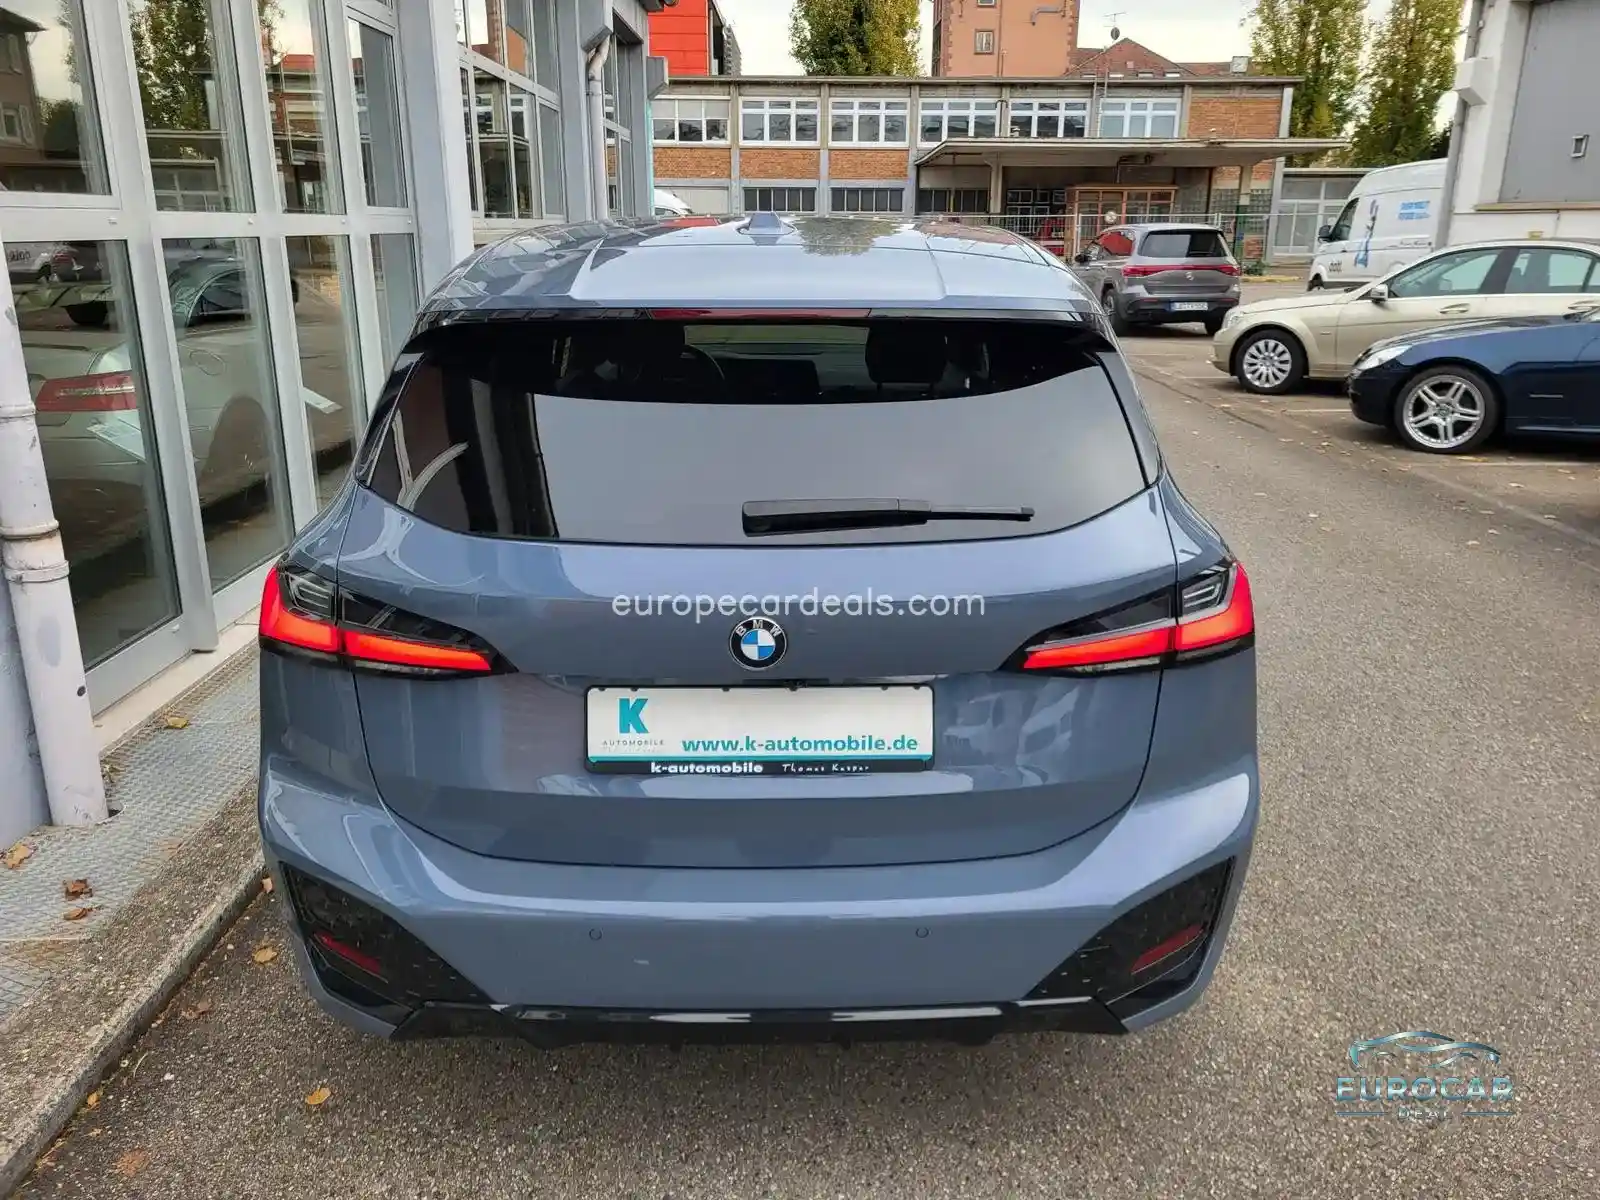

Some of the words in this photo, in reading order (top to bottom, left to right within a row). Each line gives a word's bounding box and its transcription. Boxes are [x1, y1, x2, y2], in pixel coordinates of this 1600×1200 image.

[736, 619, 782, 638] BMW
[618, 698, 649, 734] K
[681, 735, 918, 752] www.k-automobile.de
[651, 762, 764, 774] k-automobile
